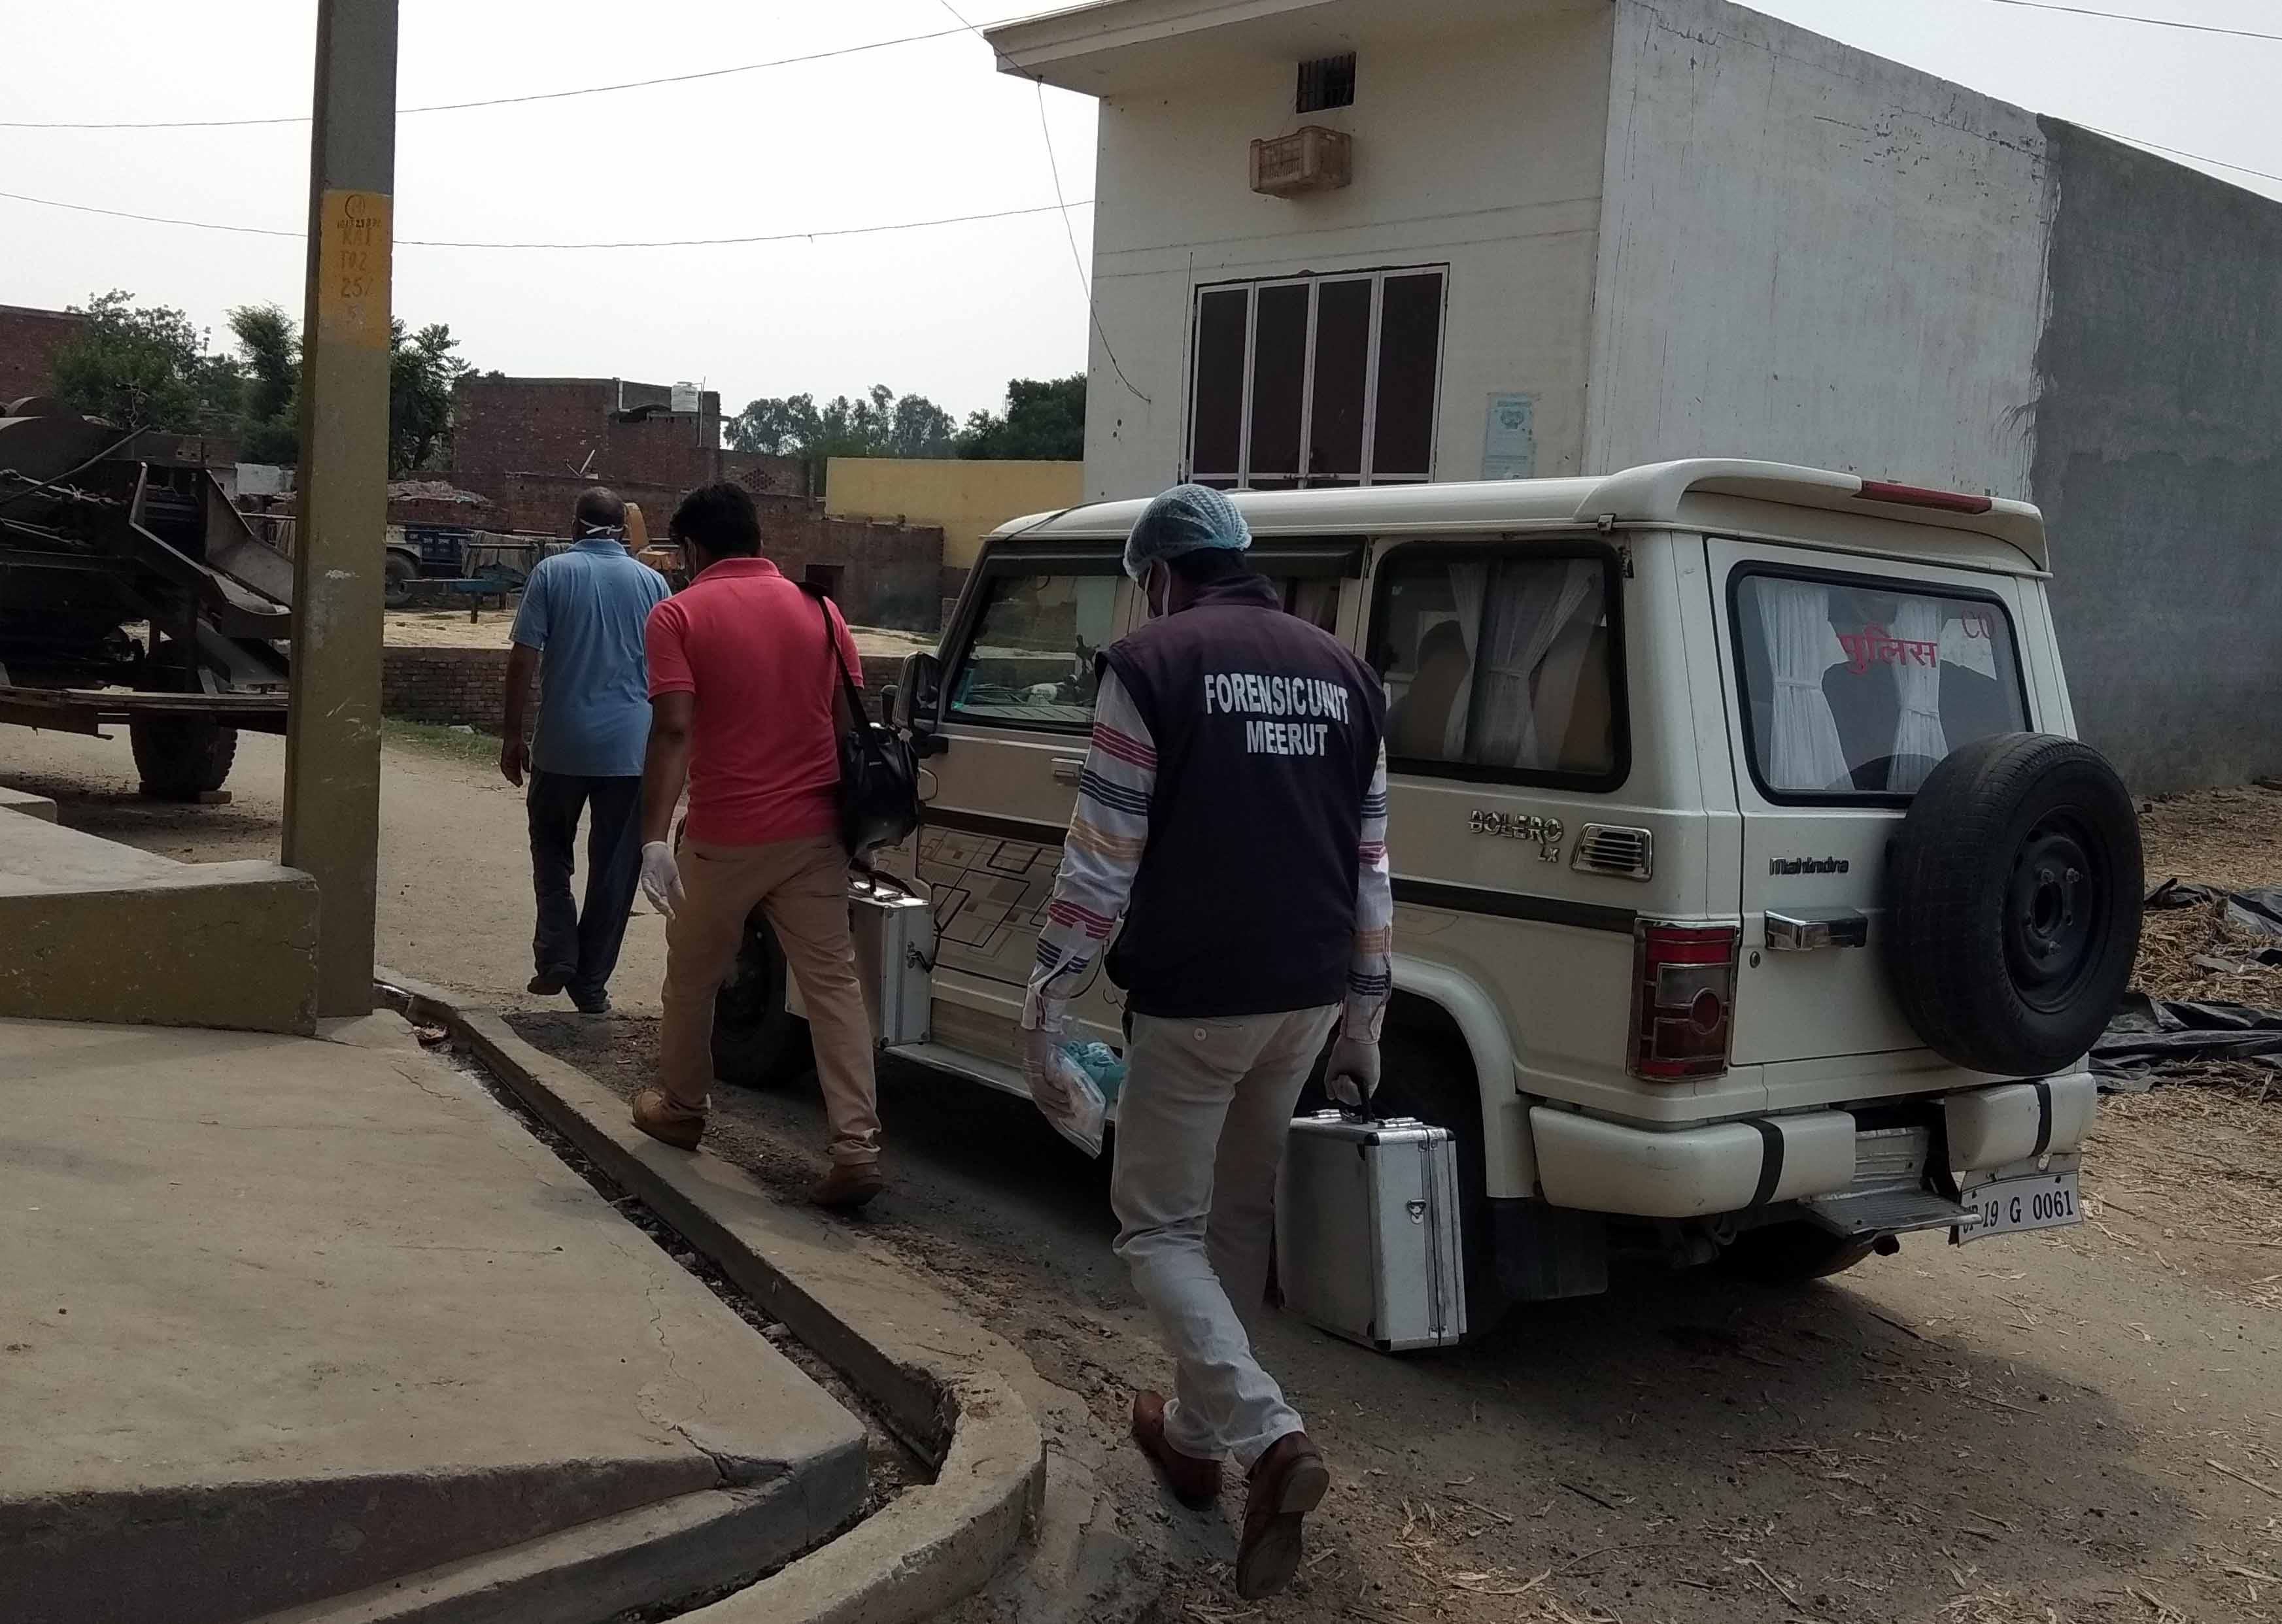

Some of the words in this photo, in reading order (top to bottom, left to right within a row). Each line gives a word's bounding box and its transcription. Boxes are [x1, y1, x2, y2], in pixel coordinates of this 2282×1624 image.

[1838, 622, 1937, 675] पुलिस
[1245, 720, 1328, 756] MEERUT
[1467, 809, 1564, 845] BOLERO
[1537, 847, 1559, 863] LX
[1983, 1200, 1999, 1227] 19
[2009, 1196, 2022, 1224] G
[2033, 1190, 2073, 1221] 0061
